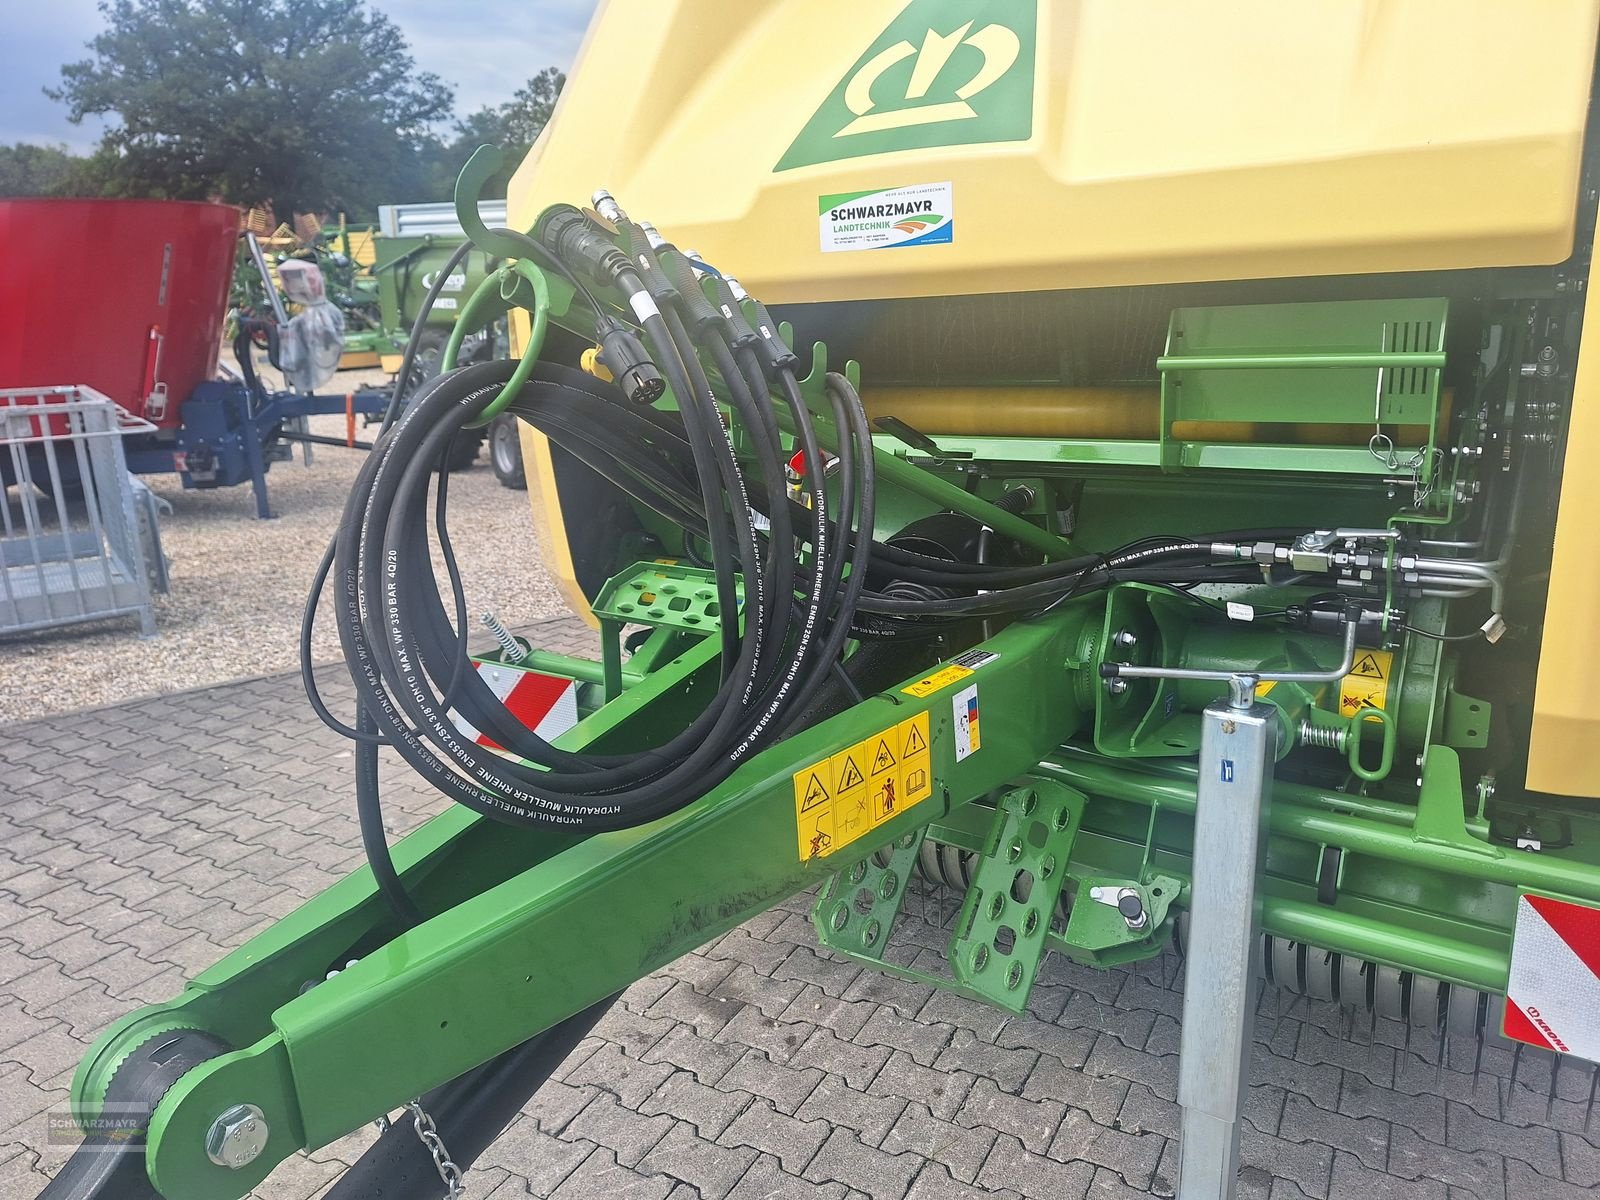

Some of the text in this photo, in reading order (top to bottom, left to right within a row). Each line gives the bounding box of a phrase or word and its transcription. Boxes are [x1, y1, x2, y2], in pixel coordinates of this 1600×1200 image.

[831, 200, 933, 221] SCHWARZMAYR
[833, 221, 891, 233] LANDTECHNIK
[460, 382, 500, 406] HYDRAULIK
[816, 489, 825, 534] HYDRAULIK
[816, 535, 825, 571] MUELLER
[1127, 553, 1142, 561] MAX.
[387, 550, 397, 578] 4Q/20
[347, 569, 356, 597] 4Q/20
[388, 582, 397, 605] BAR
[812, 572, 824, 602] RHEINE
[349, 601, 359, 624] BAR
[389, 607, 400, 625] 330
[806, 605, 818, 629] EN853
[353, 624, 363, 642] 330
[392, 627, 404, 645] WP
[801, 629, 812, 645] 2SN
[356, 643, 368, 660] WP
[398, 645, 412, 672] MAX.
[363, 660, 379, 686] MAX.
[786, 661, 801, 681] DN10
[407, 675, 425, 703] DN10
[775, 682, 791, 700] MAX.
[375, 688, 393, 714] DN10
[770, 698, 780, 714] WP
[759, 712, 772, 727] 330
[402, 731, 419, 749] 2SN
[433, 721, 451, 742] 2SN
[748, 725, 763, 742] BAR
[416, 747, 443, 773] EN853
[448, 740, 476, 768] EN853
[730, 741, 749, 761] 4Q/20
[444, 771, 478, 797] RHEINE
[476, 767, 514, 793] RHEINE
[479, 794, 525, 816] MUELLER
[513, 792, 562, 811] MUELLER
[563, 805, 620, 815] HYDRAULIK
[526, 810, 583, 824] HYDRAULIK
[1535, 1018, 1570, 1052] KRONE
